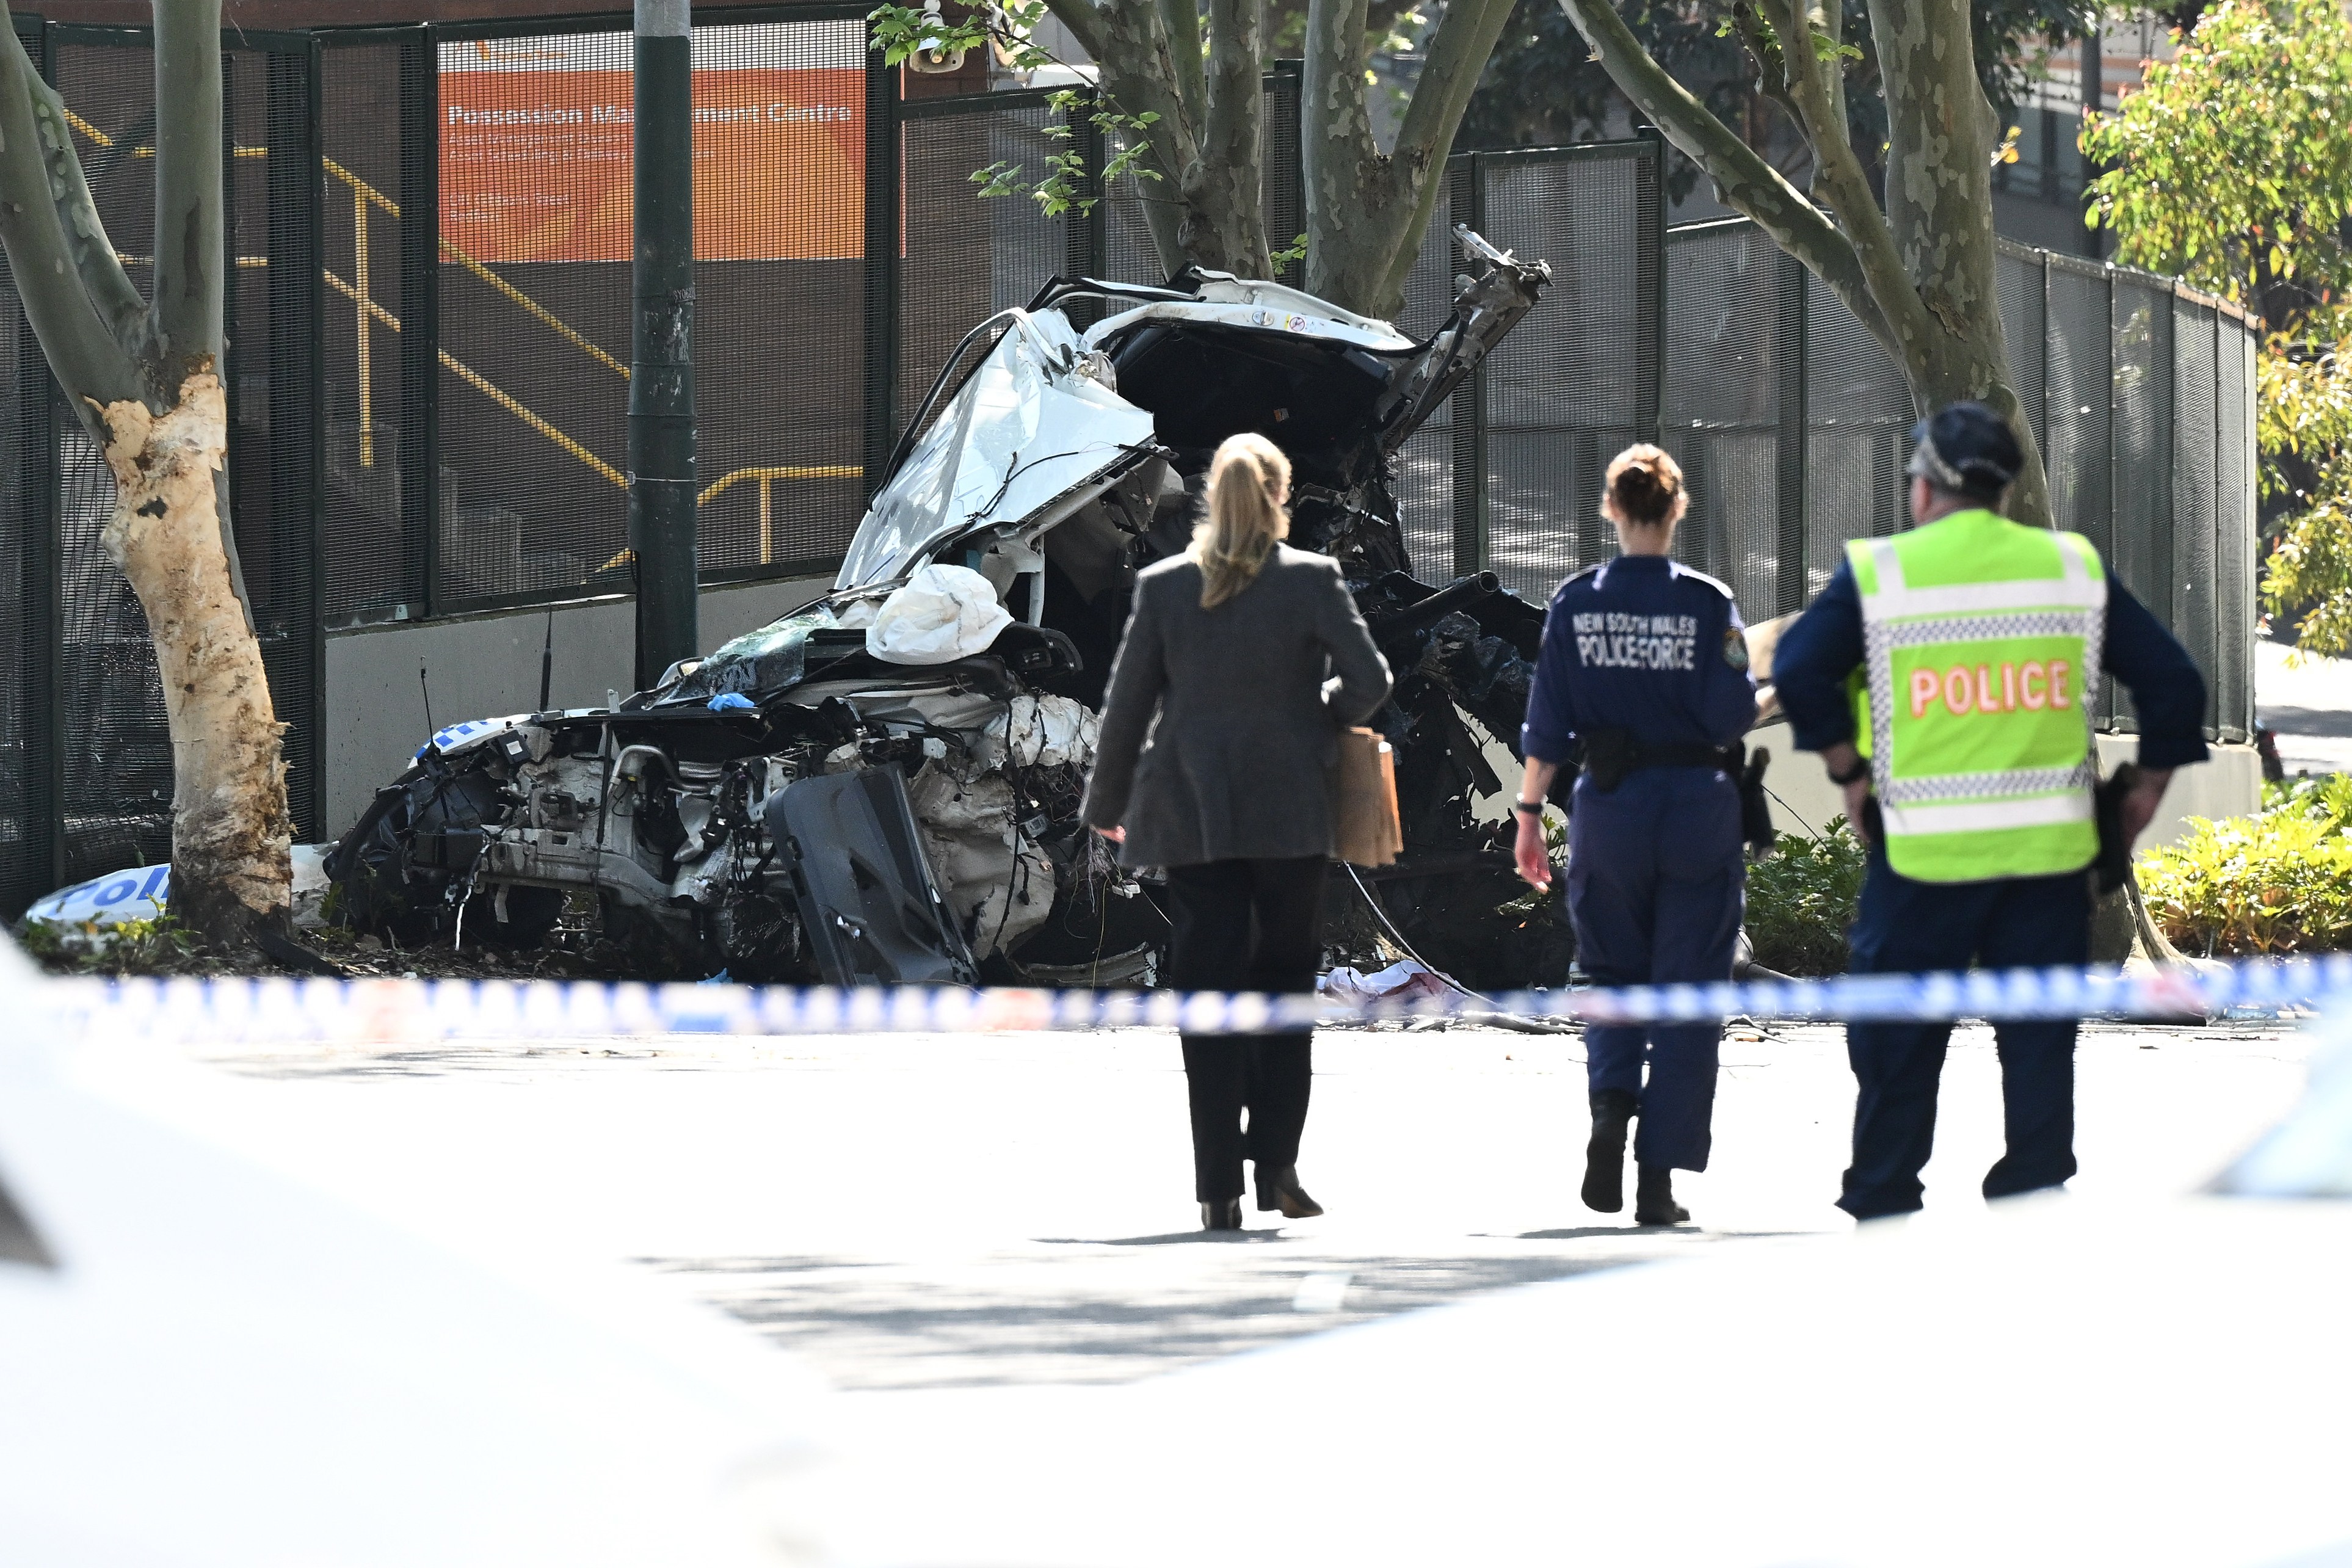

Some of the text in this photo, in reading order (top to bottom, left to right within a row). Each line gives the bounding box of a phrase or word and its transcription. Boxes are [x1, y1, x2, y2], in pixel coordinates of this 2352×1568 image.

[448, 103, 851, 125] Possession Mament Centre
[1573, 611, 1697, 636] NEW SOUTH WALES
[1576, 633, 1696, 670] POLICE FORCE
[1910, 658, 2071, 720] POLICE
